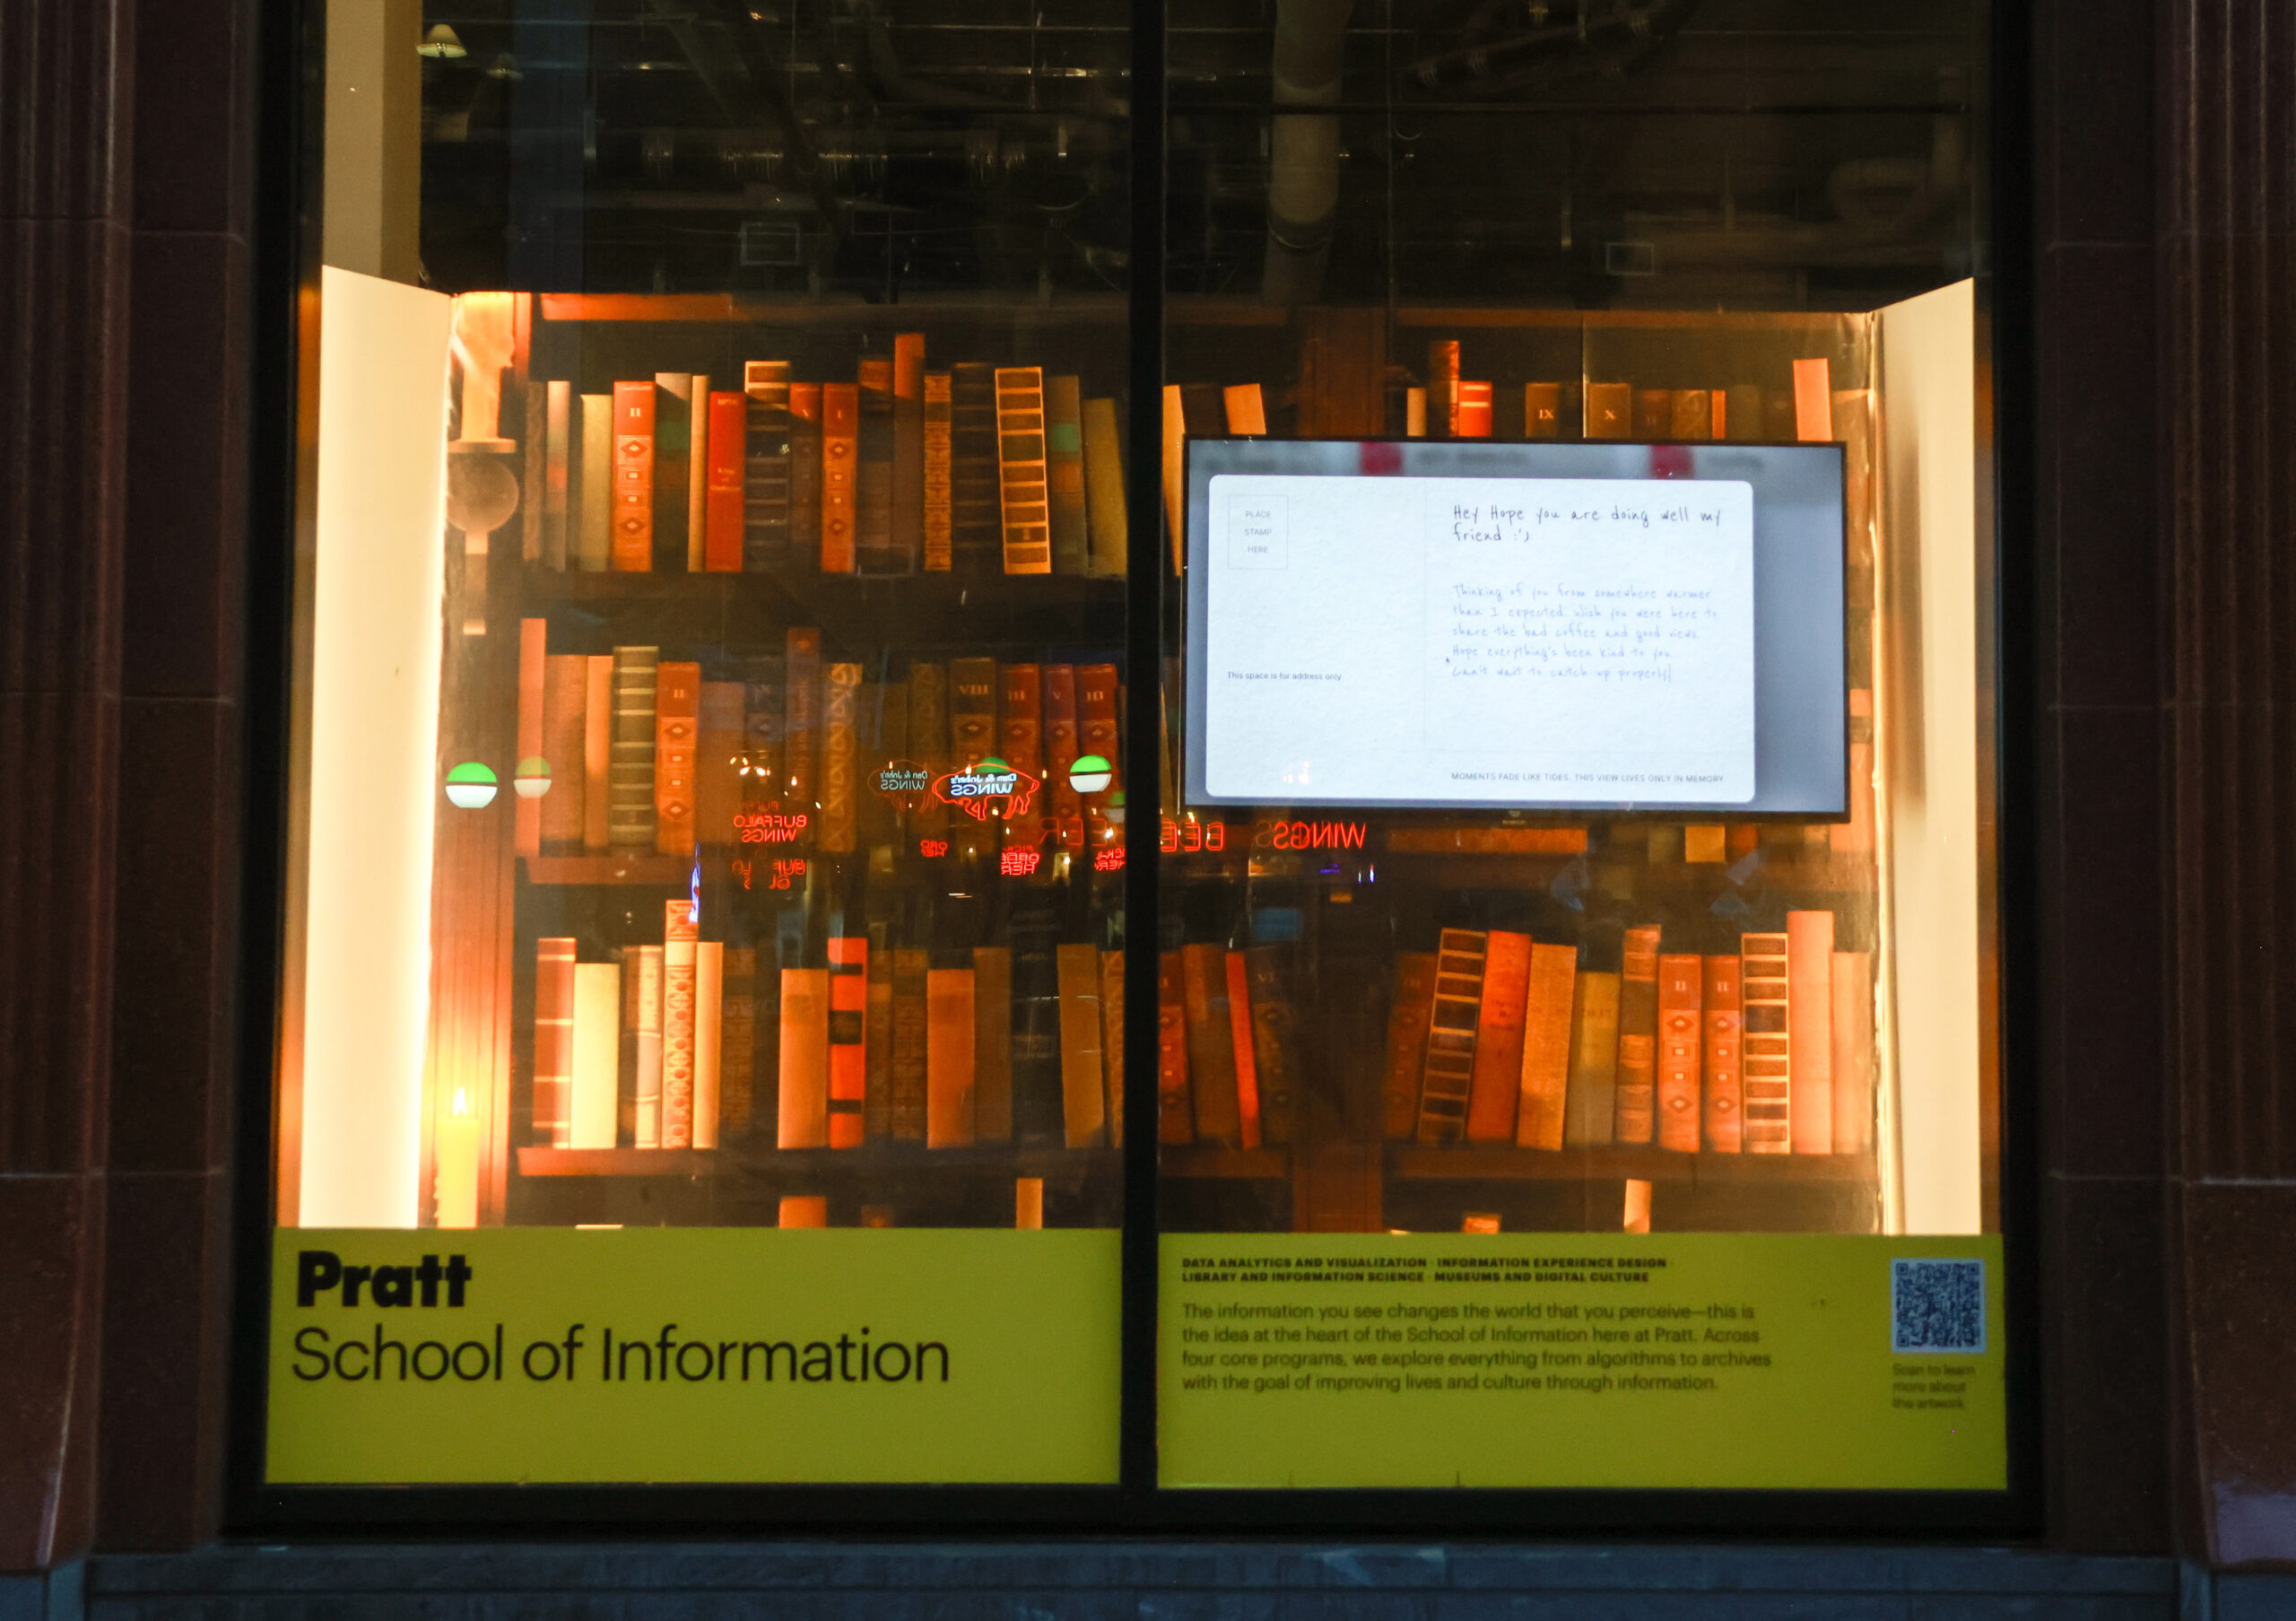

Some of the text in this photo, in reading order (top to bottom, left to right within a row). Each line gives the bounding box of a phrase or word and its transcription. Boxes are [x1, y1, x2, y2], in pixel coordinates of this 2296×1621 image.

[1539, 409, 1554, 419] IX
[1454, 504, 1721, 527] Hey Hope you are doing well my
[1453, 522, 1502, 542] friend
[1452, 581, 1711, 600] Thinking of you from somewhere warmer
[1453, 603, 1483, 616] than
[1490, 606, 1500, 617] I
[1574, 604, 1603, 618] Wish
[1611, 607, 1628, 621] you
[1635, 608, 1663, 619] were
[1671, 605, 1698, 619] here
[1703, 608, 1718, 618] to
[1452, 623, 1488, 637] share
[1494, 623, 1517, 637] the
[1523, 623, 1548, 638] bad
[1555, 621, 1596, 638] coffee
[1605, 623, 1630, 638] and
[1636, 623, 1661, 643] good
[1452, 645, 1479, 660] Hope
[1487, 642, 1558, 662] everything's
[1563, 643, 1593, 658] been
[1599, 644, 1625, 658] kind
[1631, 646, 1645, 657] to
[1228, 671, 1243, 679] This
[1246, 672, 1268, 681] space
[1325, 673, 1342, 682] only
[1452, 664, 1488, 677] Can't
[1496, 666, 1523, 677] wait
[1528, 667, 1543, 676] to
[1550, 664, 1587, 677] catch
[1596, 668, 1612, 683] up
[1451, 772, 1496, 781] MOMENTS
[1499, 772, 1520, 781] FADE
[1523, 772, 1541, 781] LIKE
[1574, 773, 1594, 782] THIS
[1596, 773, 1619, 782] VIEW
[1622, 773, 1645, 782] LIVES
[1648, 774, 1671, 783] ONLY
[1674, 774, 1683, 783] IN
[1182, 1258, 1667, 1268] DATA ANALYTICS AND VISUALIZATION INFORMATION EXPERIENCE DESIGN
[297, 1251, 474, 1310] Pratt
[1182, 1272, 1649, 1283] LIBRARY AND INFORMATION SCIENCE MUSEUMS AND DIGITAL CULTURE
[1182, 1303, 1213, 1319] The
[1218, 1303, 1315, 1319] information
[1318, 1306, 1349, 1322] you
[1353, 1306, 1383, 1319] see
[1387, 1303, 1459, 1322] changes
[1463, 1303, 1491, 1319] the
[1494, 1303, 1543, 1320] world
[1546, 1303, 1579, 1320] that
[1584, 1307, 1614, 1323] you
[1741, 1303, 1755, 1320] is
[1182, 1326, 1761, 1344] the idea at the heart of the School of Information here at Pratt. Across
[292, 1323, 950, 1382] School of Information
[1182, 1349, 1773, 1371] four core programs, we explore everything from algorithms to archives
[1182, 1373, 1719, 1394] with the goal of improving lives and culture through information.
